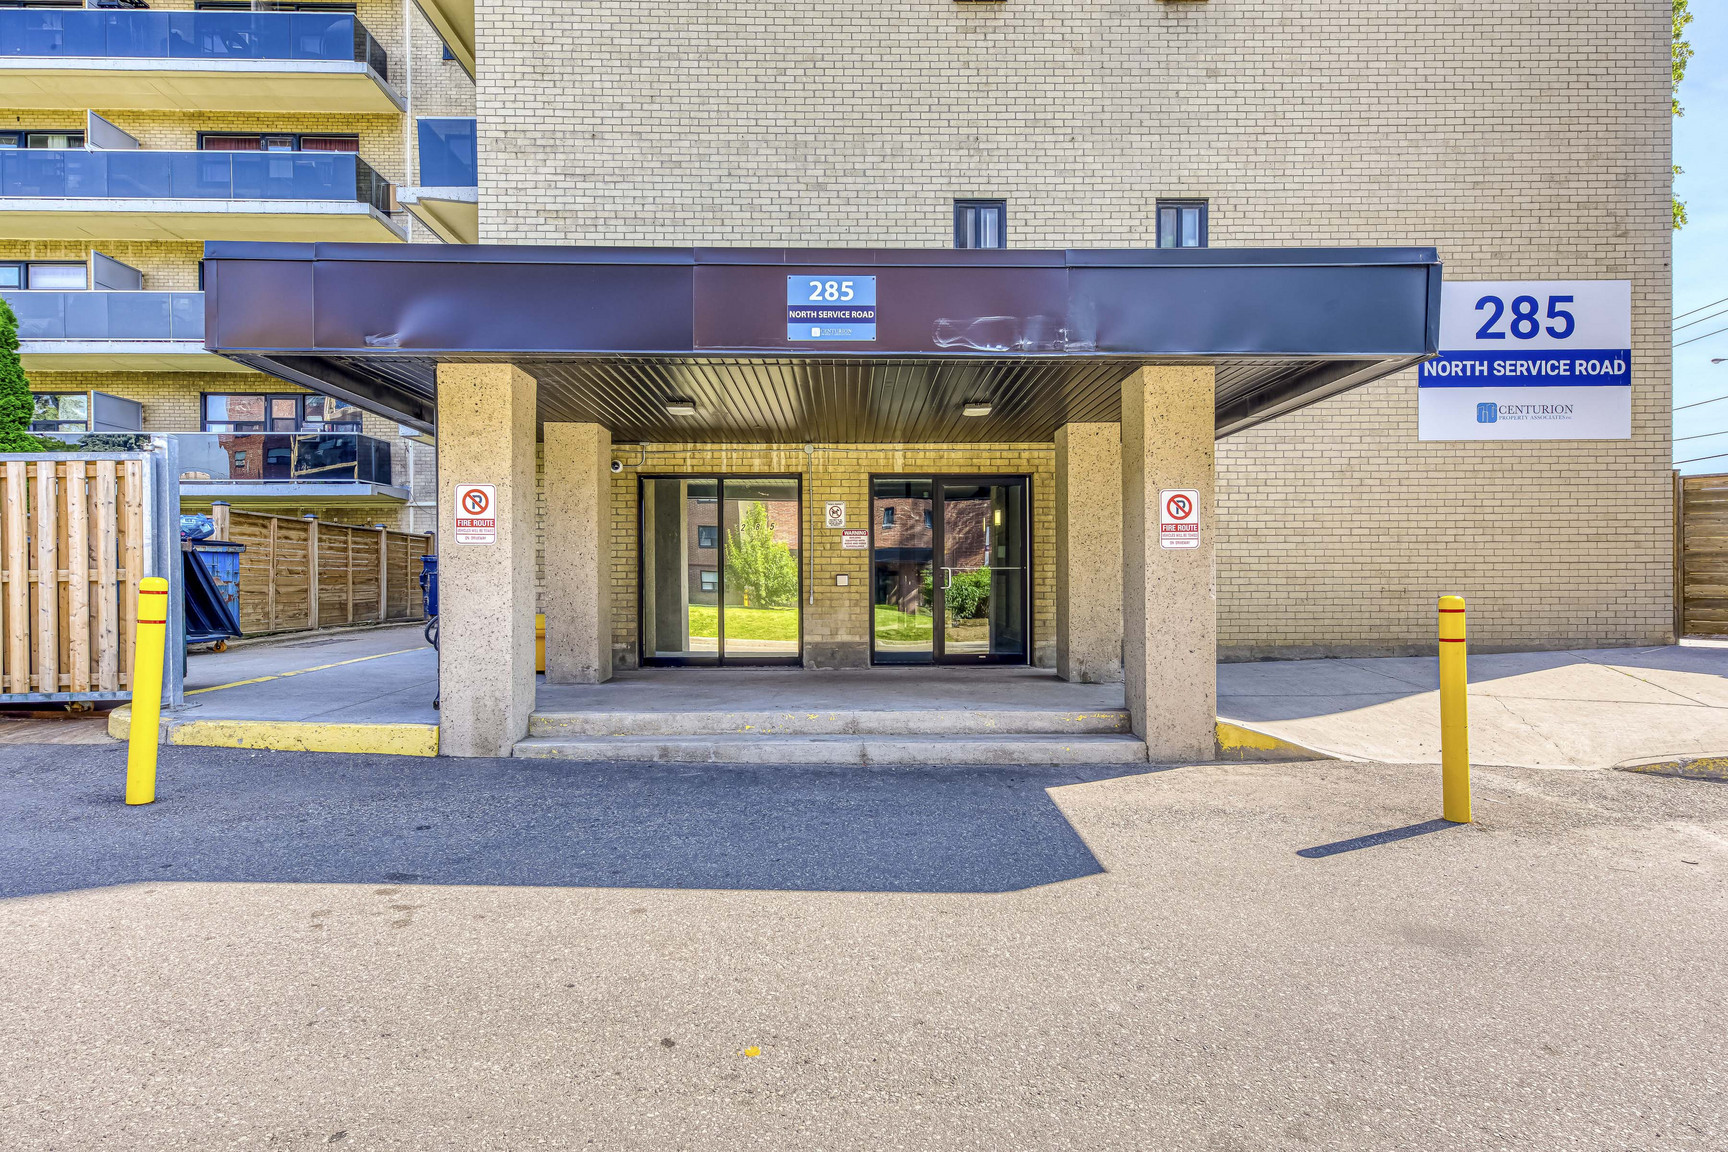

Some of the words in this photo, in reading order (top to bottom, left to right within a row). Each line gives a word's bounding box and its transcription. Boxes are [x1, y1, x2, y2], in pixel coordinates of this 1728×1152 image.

[809, 281, 854, 301] 285
[1475, 295, 1575, 340] 285
[1423, 360, 1488, 377] NORTH
[1493, 360, 1571, 376] SERVICE
[1575, 359, 1626, 375] ROAD
[1498, 404, 1574, 415] CENTURION
